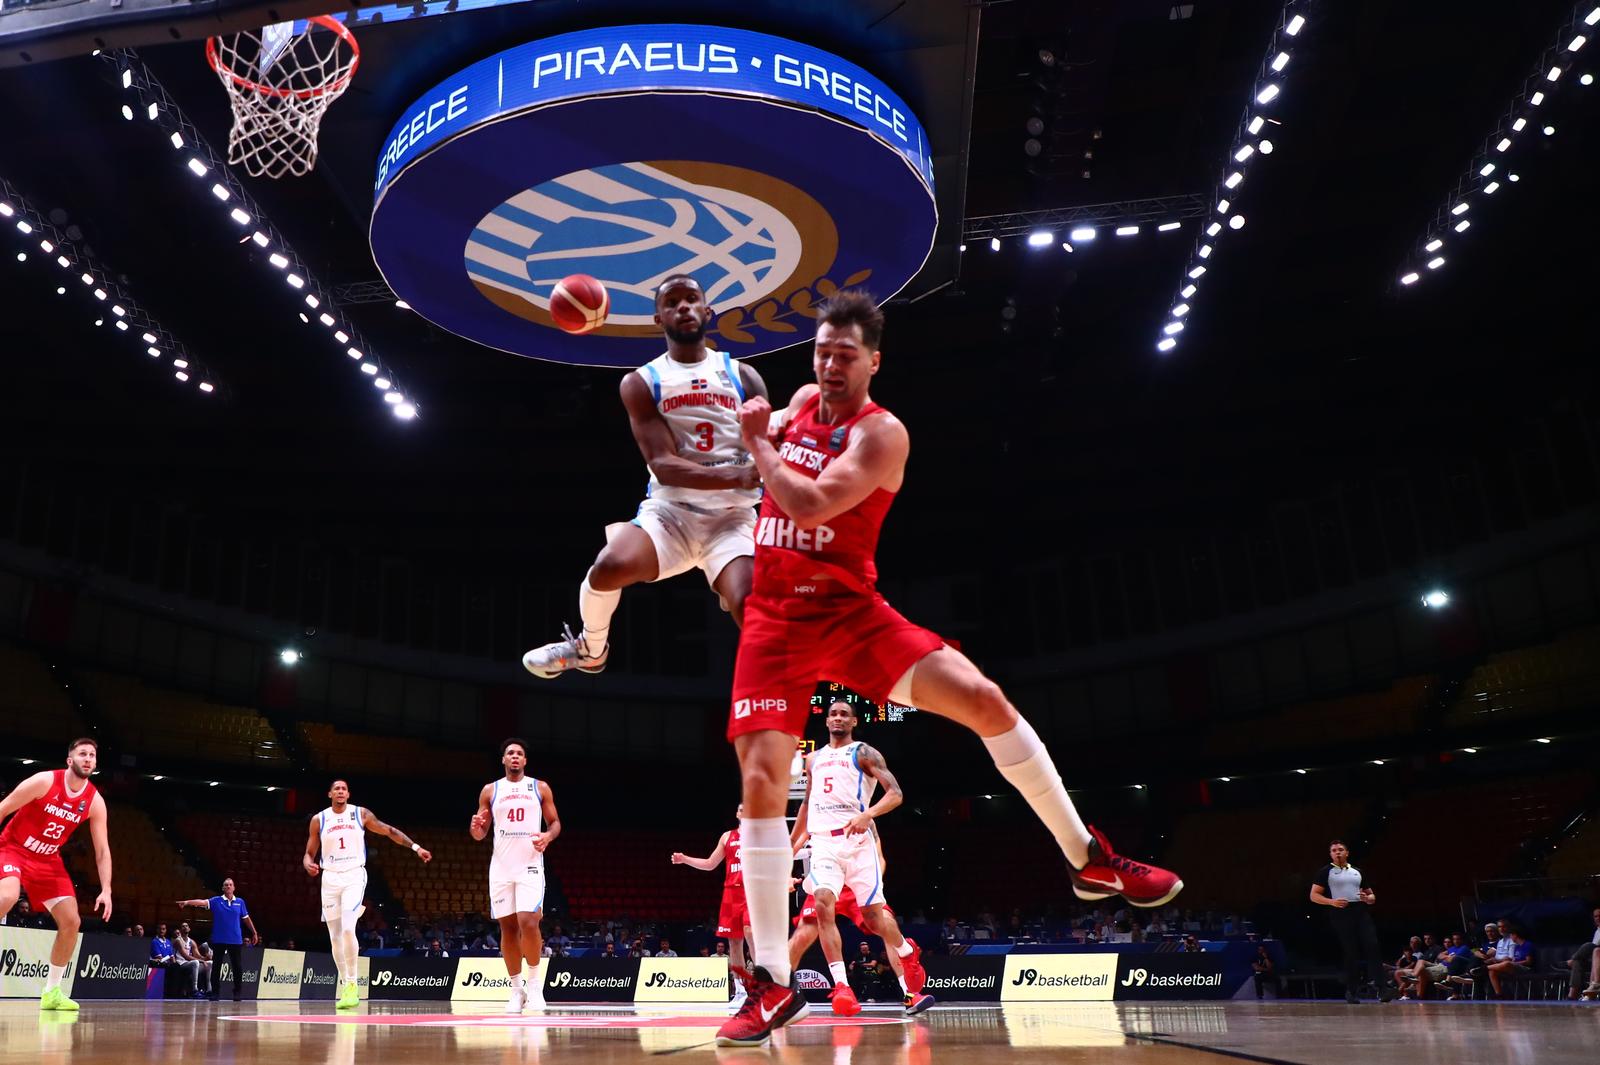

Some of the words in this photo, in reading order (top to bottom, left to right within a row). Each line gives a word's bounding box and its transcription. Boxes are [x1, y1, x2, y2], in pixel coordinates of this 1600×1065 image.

[533, 42, 739, 89] PIRAEUS
[774, 53, 908, 142] GREECE
[377, 85, 468, 190] GREECE
[663, 392, 738, 413] DOMINICANA
[695, 422, 714, 453] 3
[779, 442, 836, 472] RVATSK
[752, 698, 788, 712] HPB
[810, 695, 822, 705] 27
[823, 777, 834, 794] 5
[44, 803, 82, 824] HRVATSKA
[507, 807, 525, 823] 40
[42, 821, 66, 840] 23
[338, 837, 346, 850] 1
[80, 953, 148, 980] J9.basketball
[371, 970, 449, 987] J9.basketball
[549, 971, 632, 988] J9.basketball
[645, 972, 727, 989] J9.basketball
[1012, 968, 1109, 987] J9.basketball
[1121, 968, 1222, 987] J9.basketball
